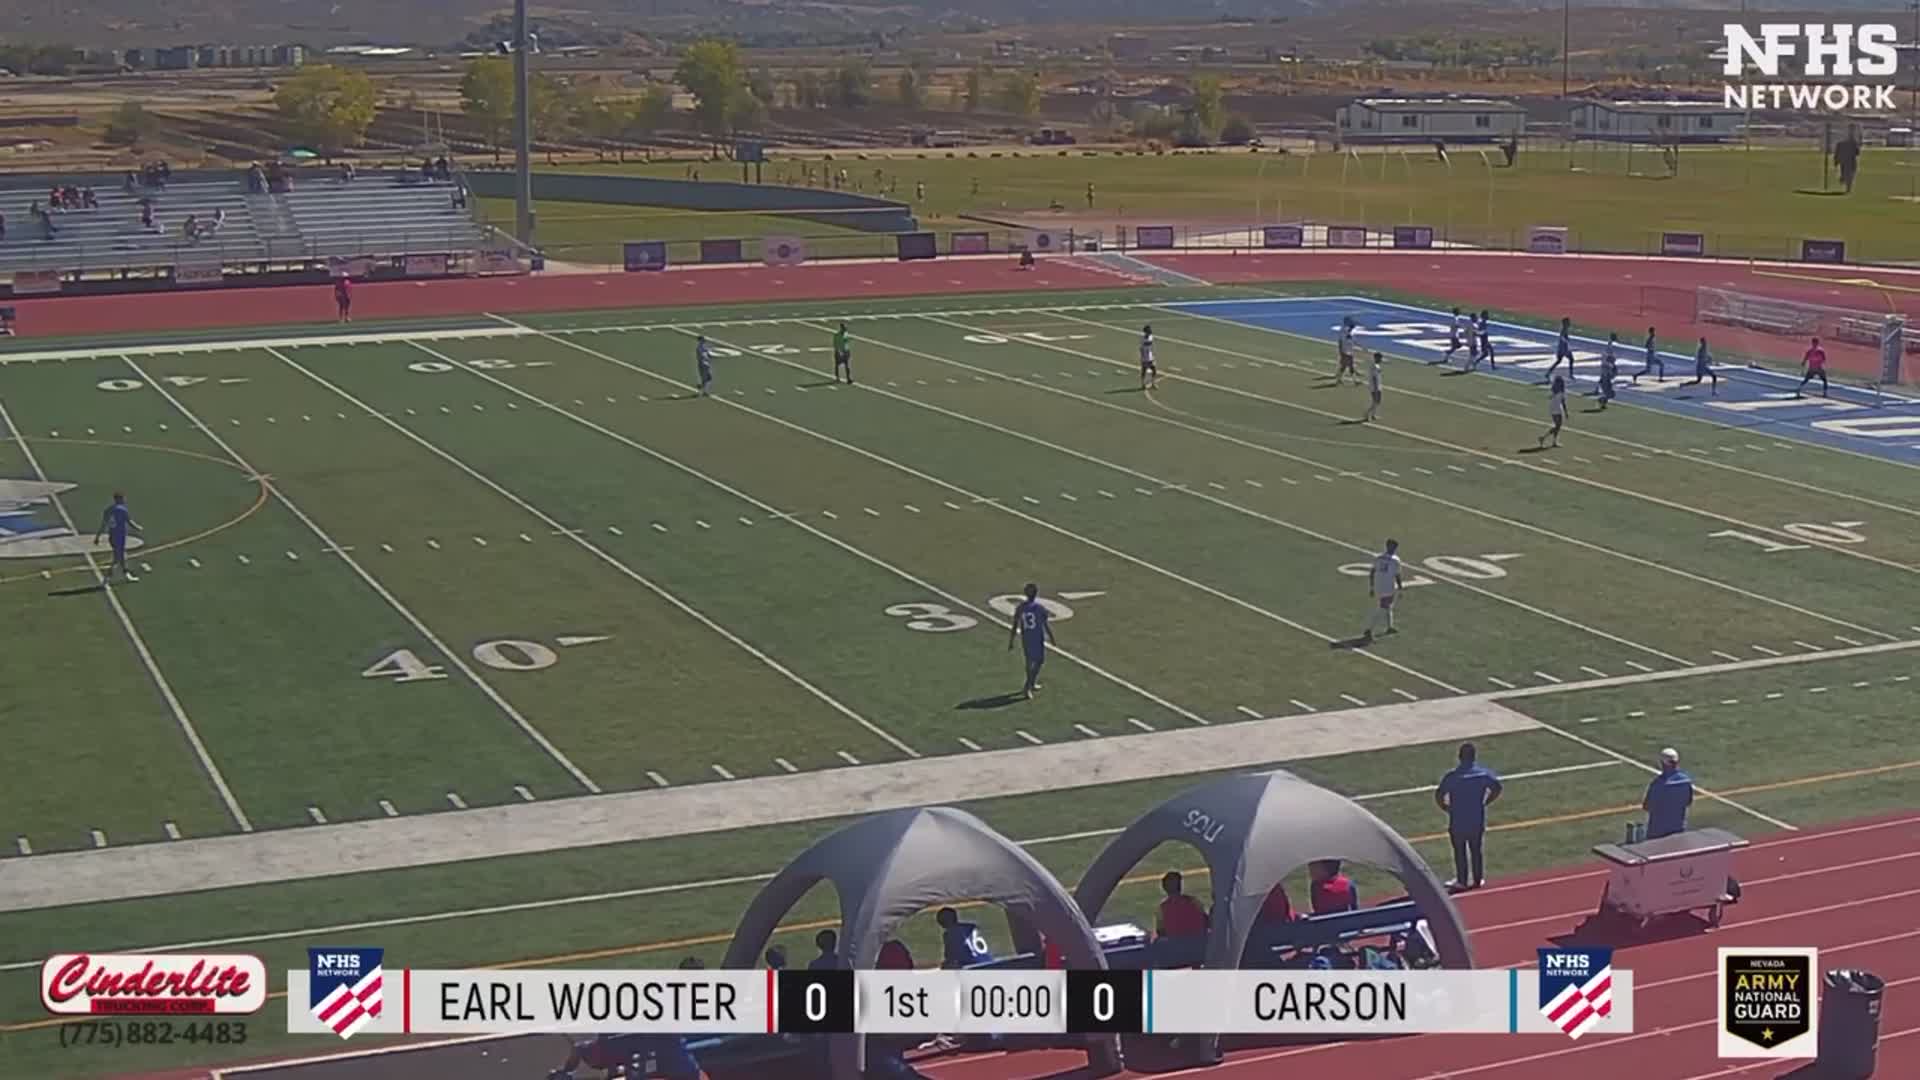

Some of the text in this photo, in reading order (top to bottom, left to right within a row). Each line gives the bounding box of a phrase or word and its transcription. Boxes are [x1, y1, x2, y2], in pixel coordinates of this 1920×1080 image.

[1709, 521, 1867, 552] 10
[1022, 612, 1036, 629] 13
[361, 639, 558, 682] 40
[965, 928, 988, 957] 16
